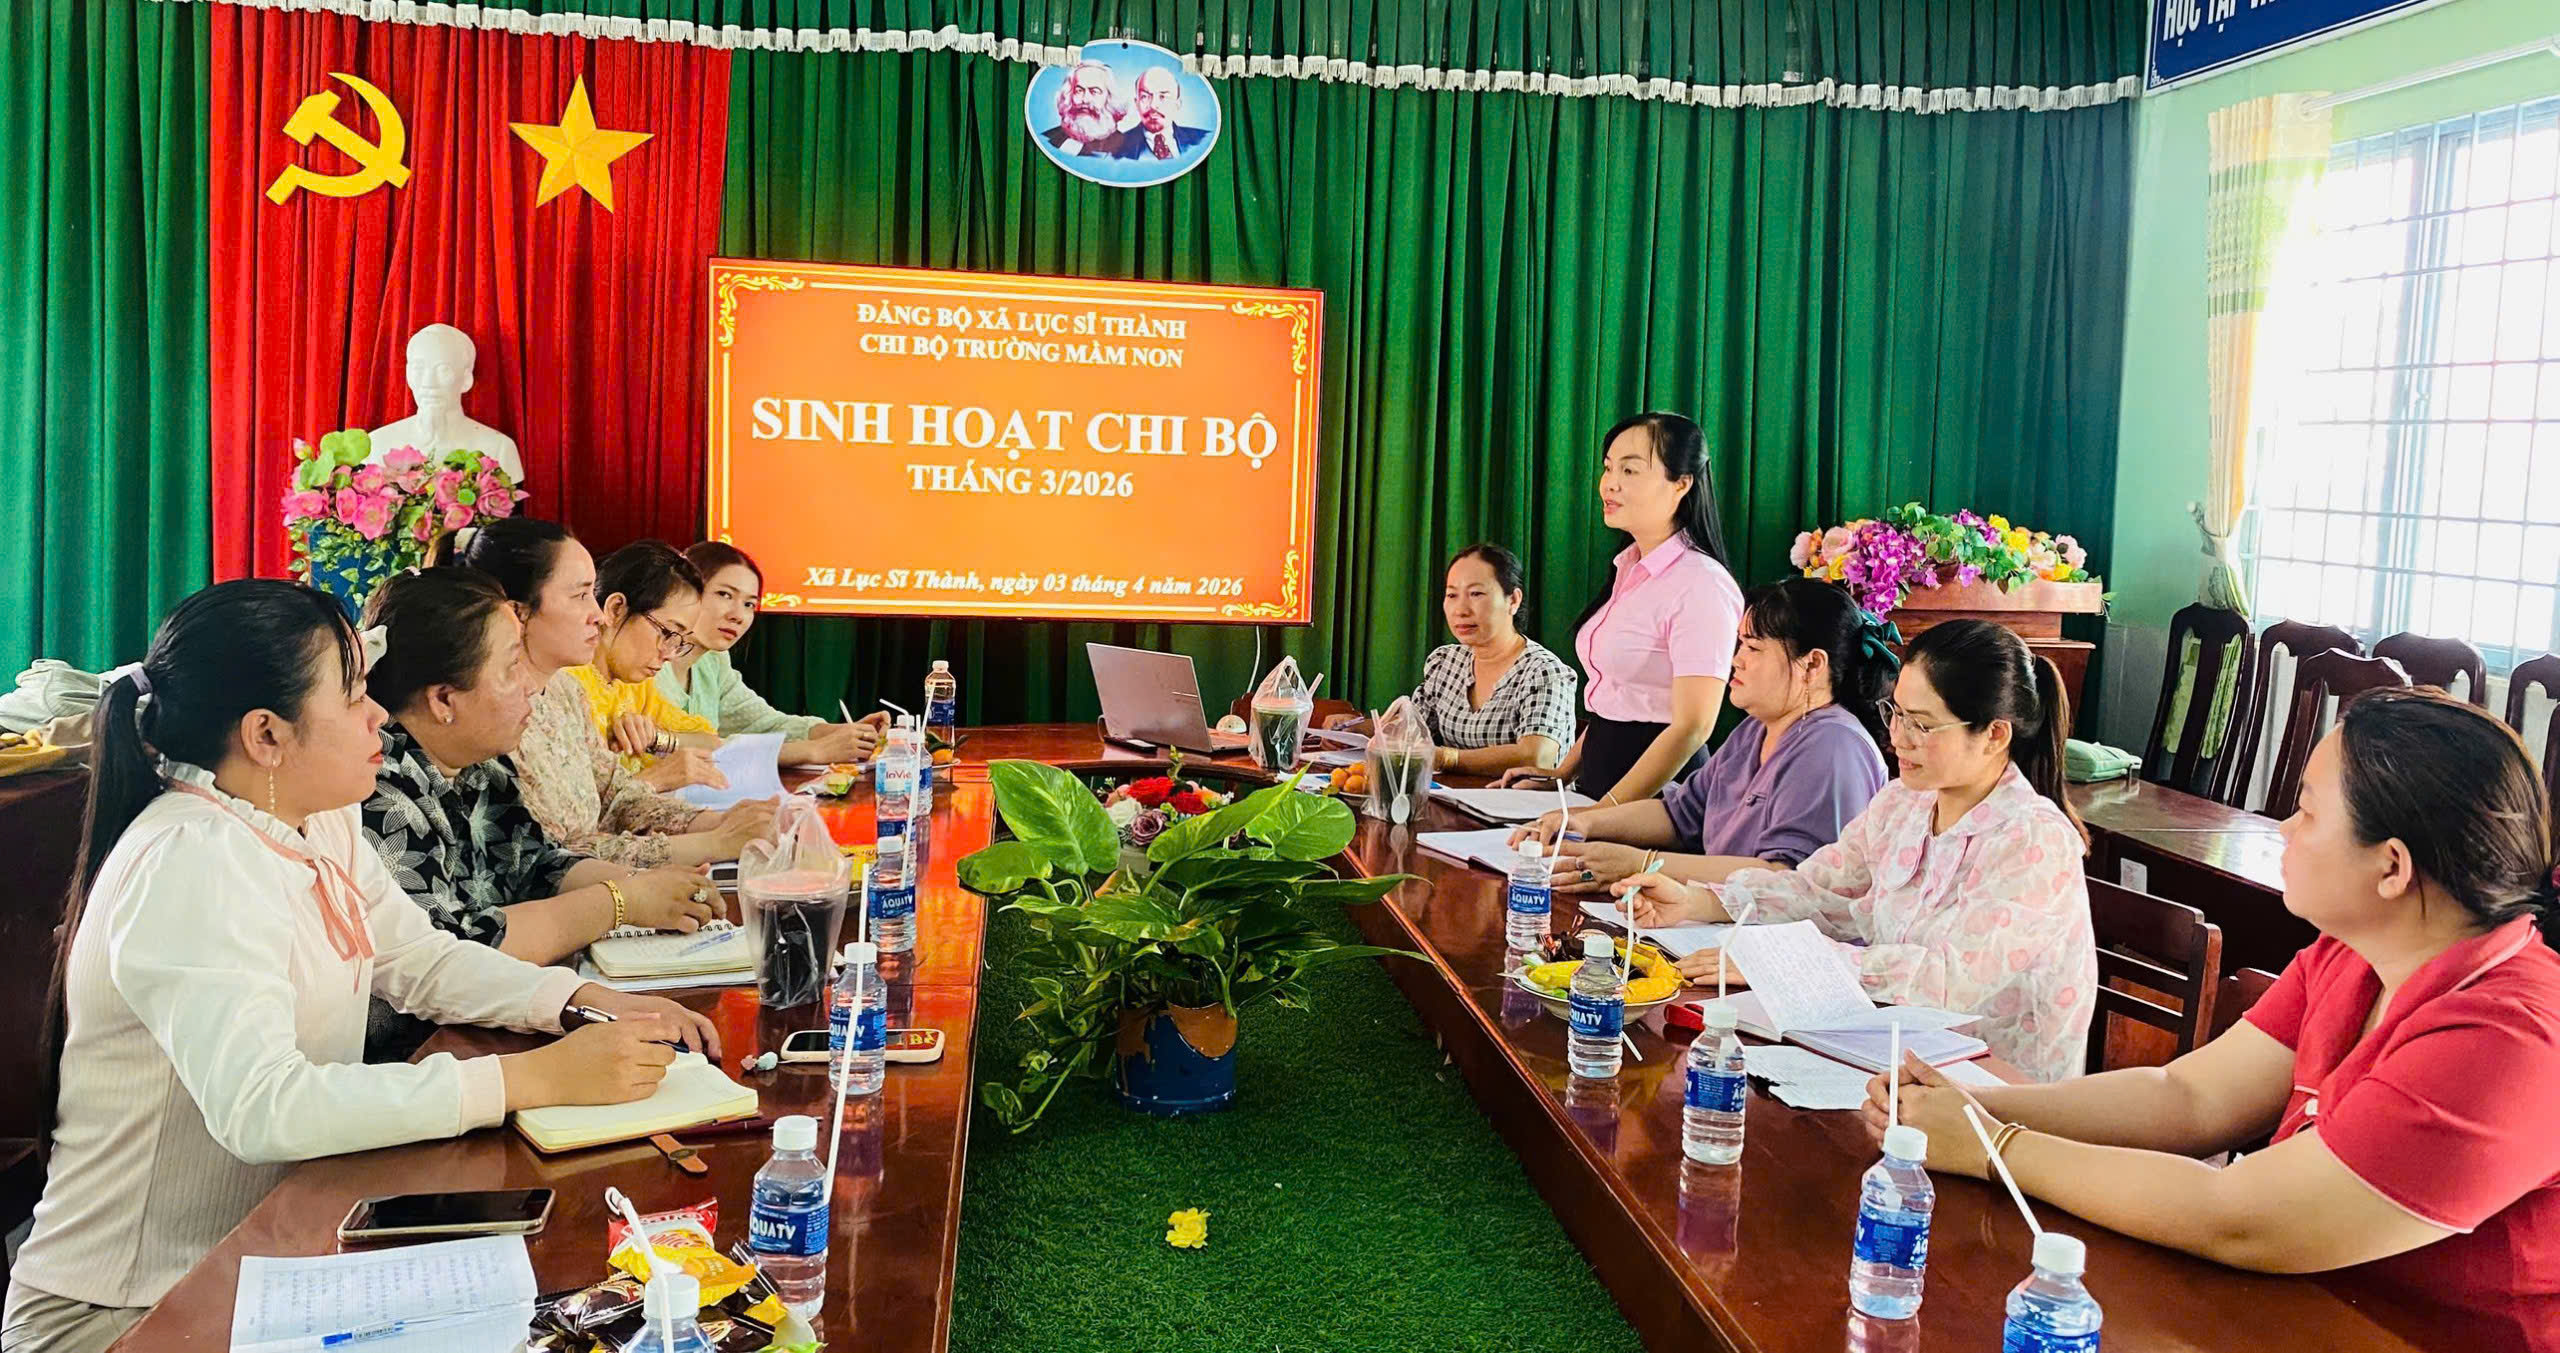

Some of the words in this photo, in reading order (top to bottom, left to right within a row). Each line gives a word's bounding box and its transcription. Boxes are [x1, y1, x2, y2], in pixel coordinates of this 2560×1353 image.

[856, 299, 932, 327] ĐẢNG
[935, 305, 974, 333] BỘ
[975, 306, 1013, 331] XÃ
[1016, 311, 1069, 337] LỤC
[1072, 311, 1097, 336] SĨ
[1101, 313, 1187, 340] THÀNH
[859, 333, 908, 355] CHI
[911, 334, 949, 361] BỘ
[953, 335, 1061, 363] TRƯỜNG
[1130, 346, 1184, 368] NON
[751, 397, 894, 445] SINH
[907, 404, 1073, 461] HOẠT
[1086, 412, 1188, 456] CHI
[1201, 411, 1278, 470] BỘ
[906, 459, 1033, 495] THÁNG
[1038, 468, 1134, 498] 3/2026
[803, 567, 836, 587] Xã
[838, 567, 881, 592] Lục
[884, 568, 910, 588] Sĩ
[914, 569, 986, 593] Thành,
[989, 572, 1039, 596] ngày
[1042, 573, 1068, 592] 03
[1070, 574, 1130, 598] tháng
[1131, 576, 1146, 594] 4
[1148, 576, 1192, 595] năm
[1195, 577, 1244, 597] 2026
